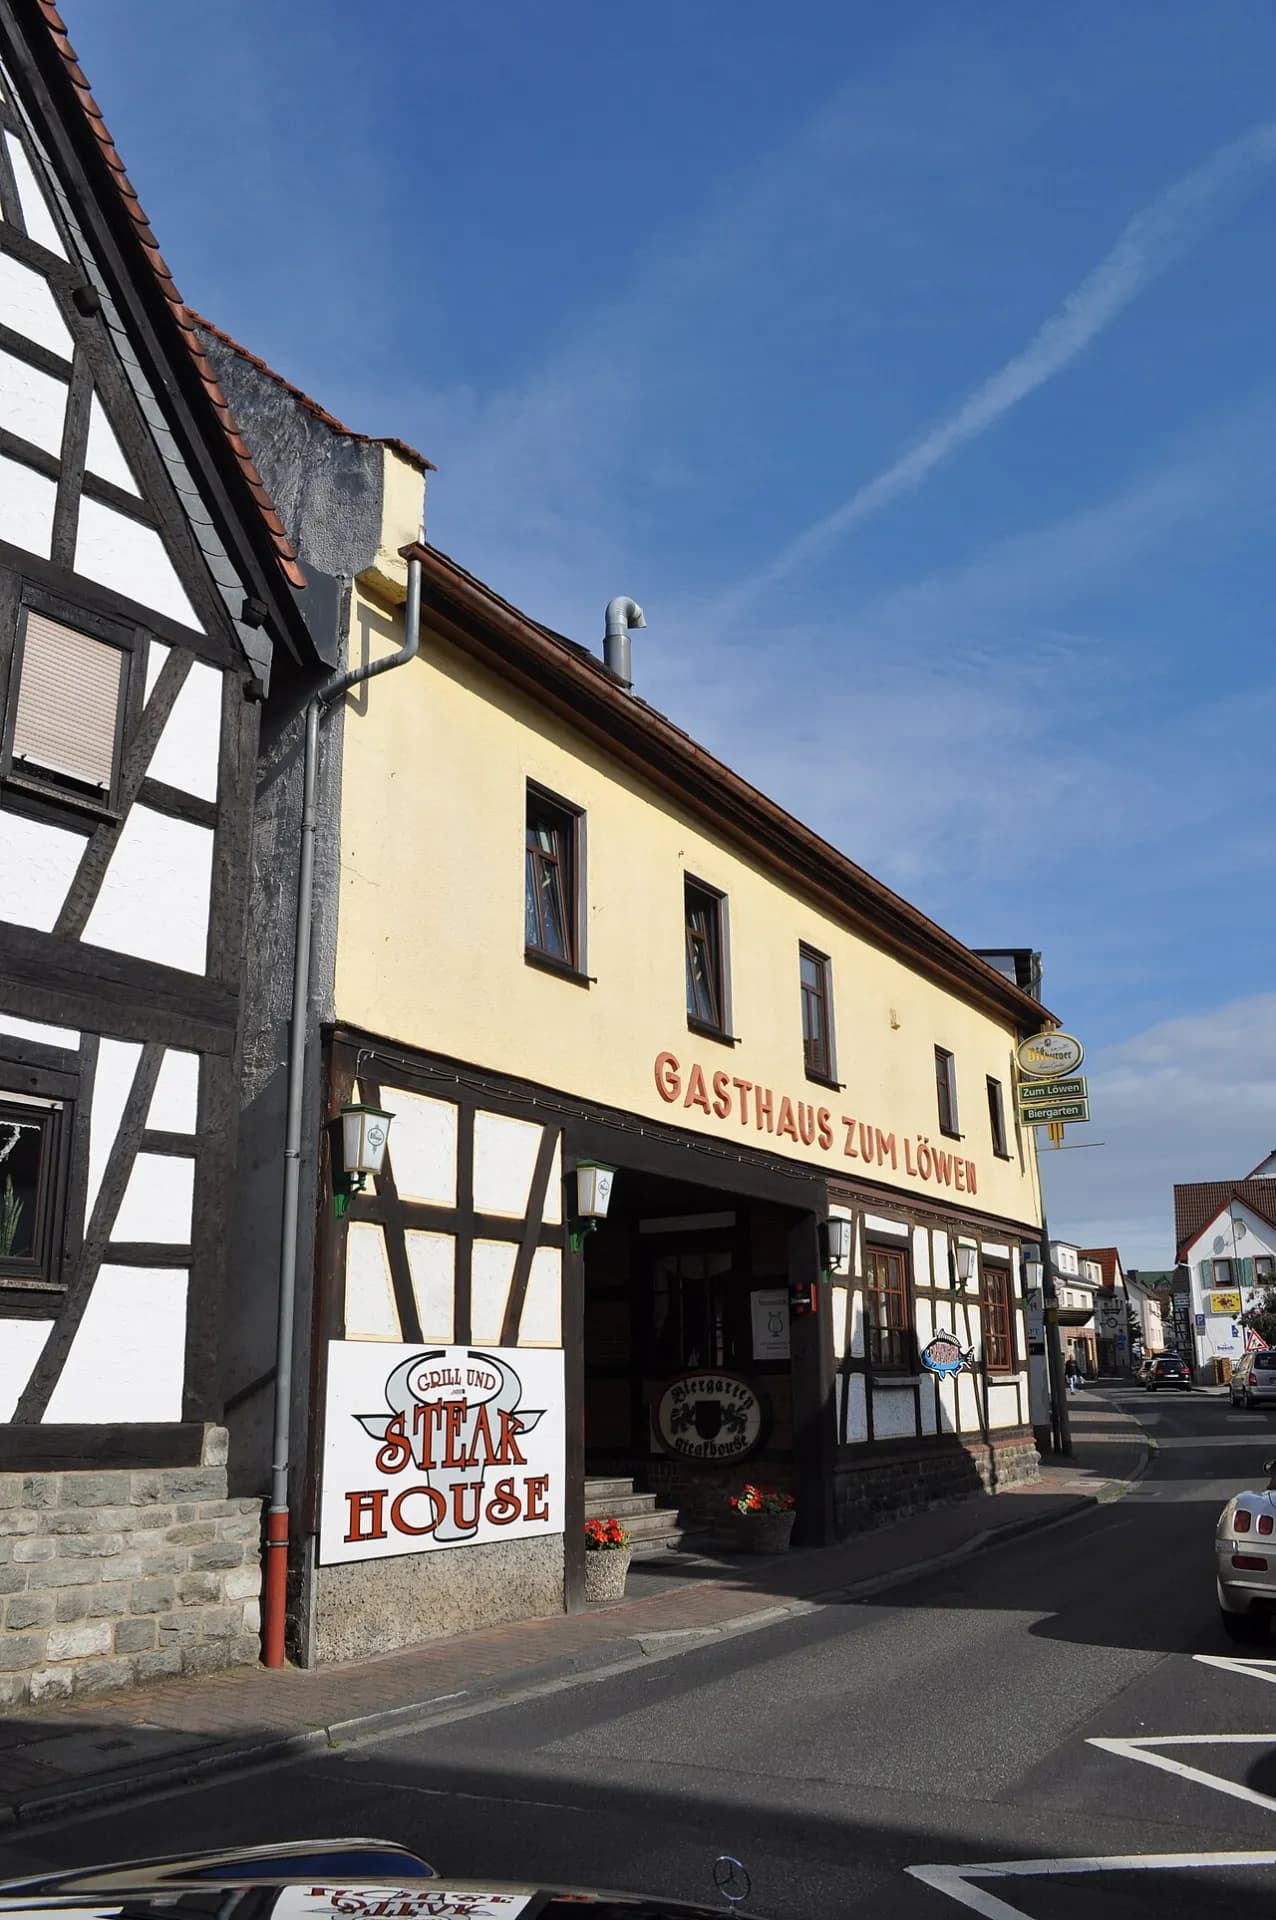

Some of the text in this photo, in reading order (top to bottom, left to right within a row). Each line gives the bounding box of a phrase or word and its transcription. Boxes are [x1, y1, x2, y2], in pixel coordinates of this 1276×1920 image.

[1023, 1084, 1080, 1097] Zum Löwen
[654, 1051, 977, 1195] GASTHAUS ZUM LÖWEN
[1028, 1106, 1079, 1119] Biergarten
[417, 1368, 496, 1391] GRILL UND
[671, 1379, 754, 1411] Biergarten
[375, 1397, 528, 1475] STEAK
[343, 1474, 550, 1543] HOUSE
